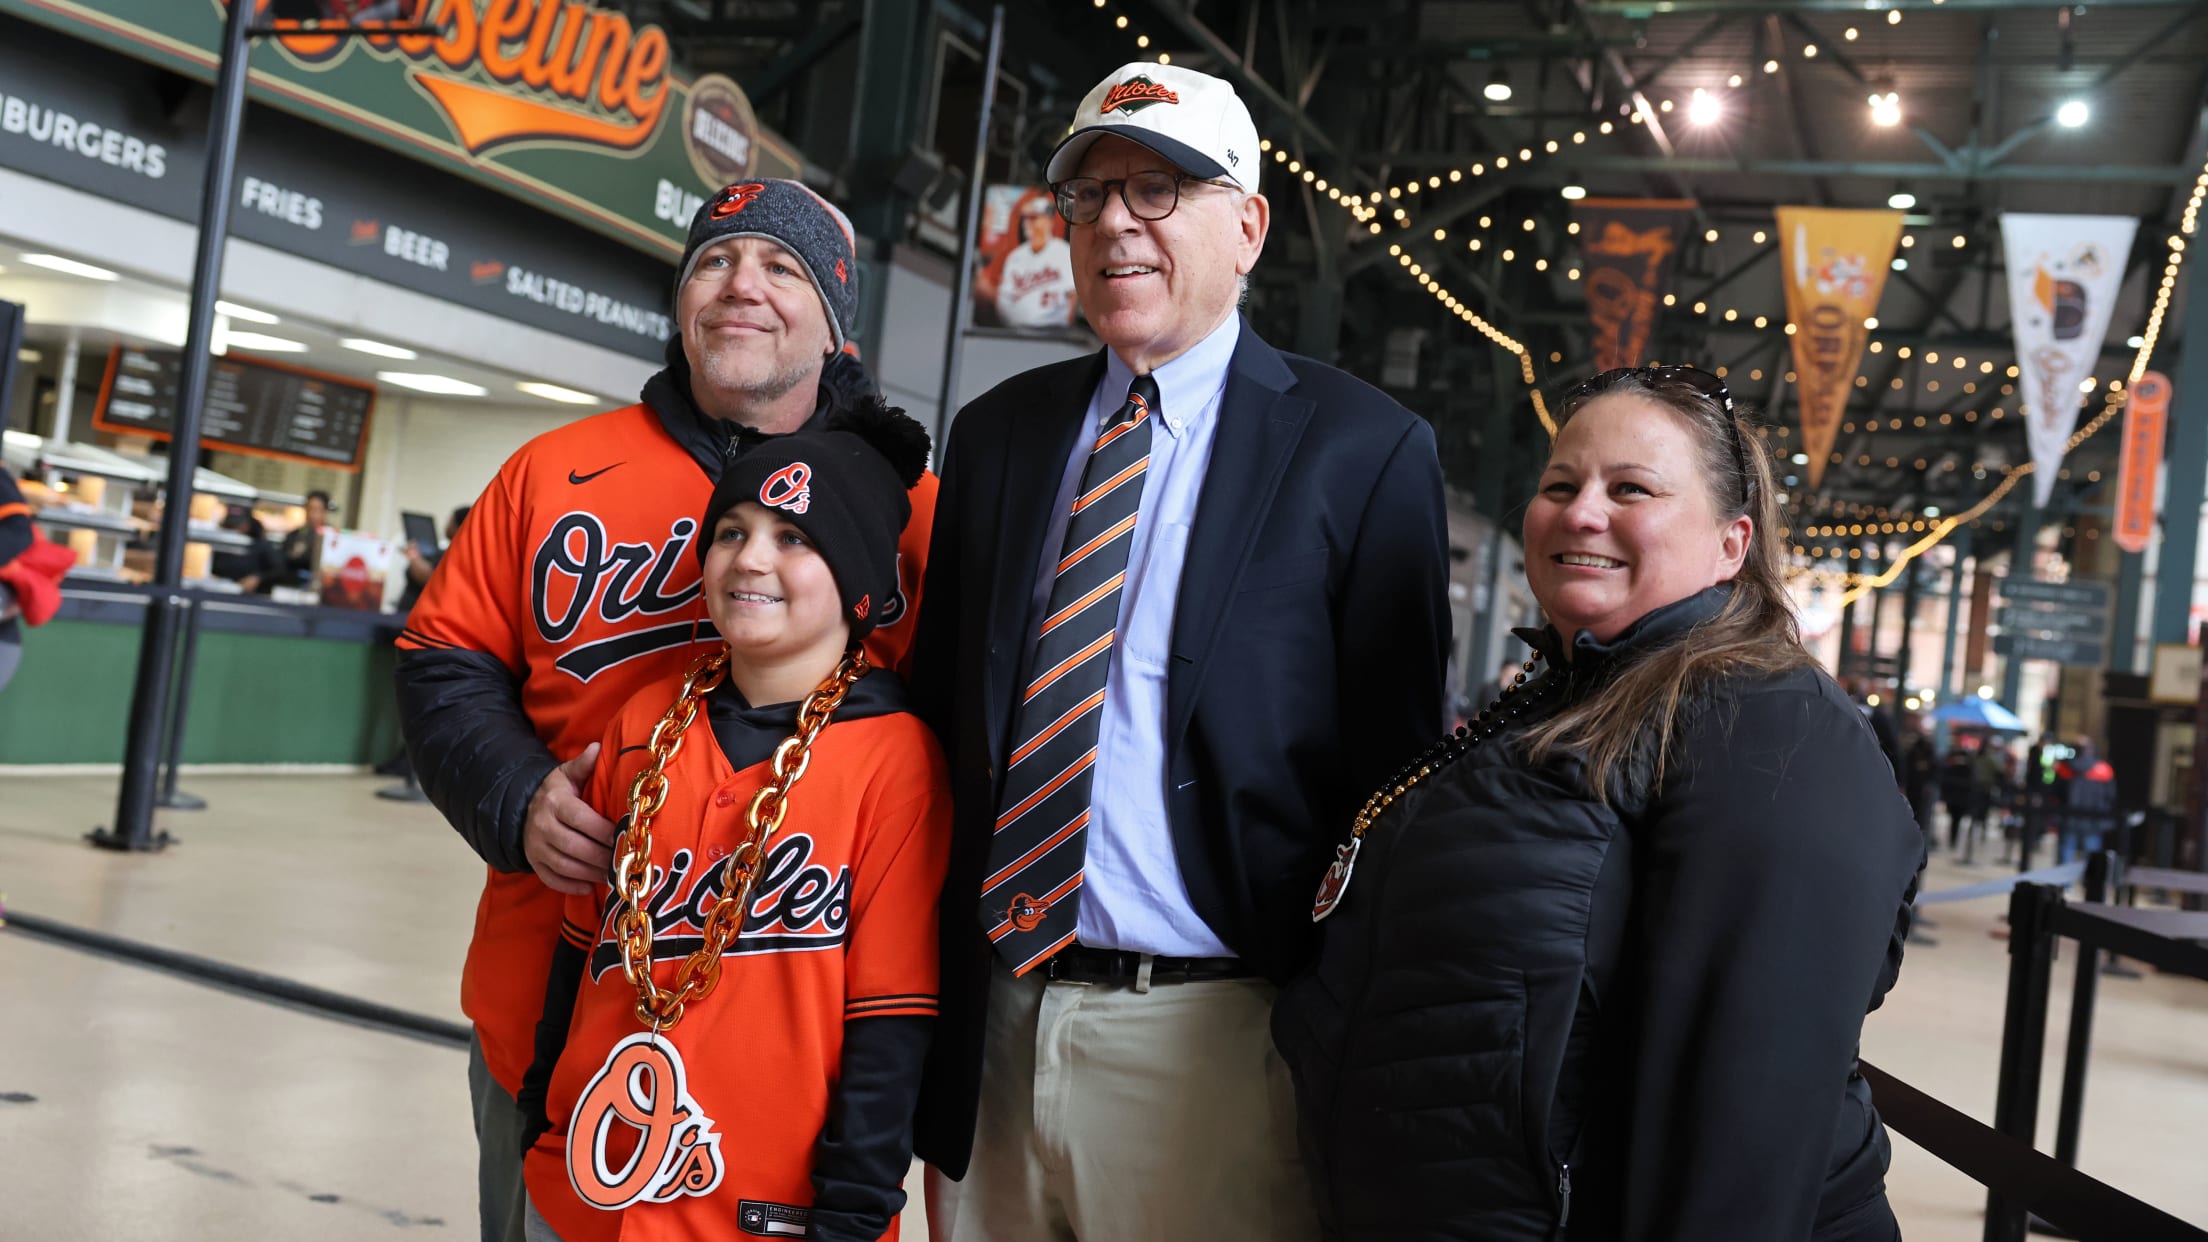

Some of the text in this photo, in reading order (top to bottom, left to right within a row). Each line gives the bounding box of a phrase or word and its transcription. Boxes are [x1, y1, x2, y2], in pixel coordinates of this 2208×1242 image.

[220, 0, 669, 125] seline
[1101, 80, 1179, 114] Orioles
[0, 92, 167, 179] BURGERS
[241, 176, 323, 230] FRIES
[384, 225, 449, 271] BEER
[506, 266, 584, 313] SALTED
[583, 292, 670, 341] PEANUTS
[760, 462, 812, 514] O's
[565, 1040, 718, 1207] O's
